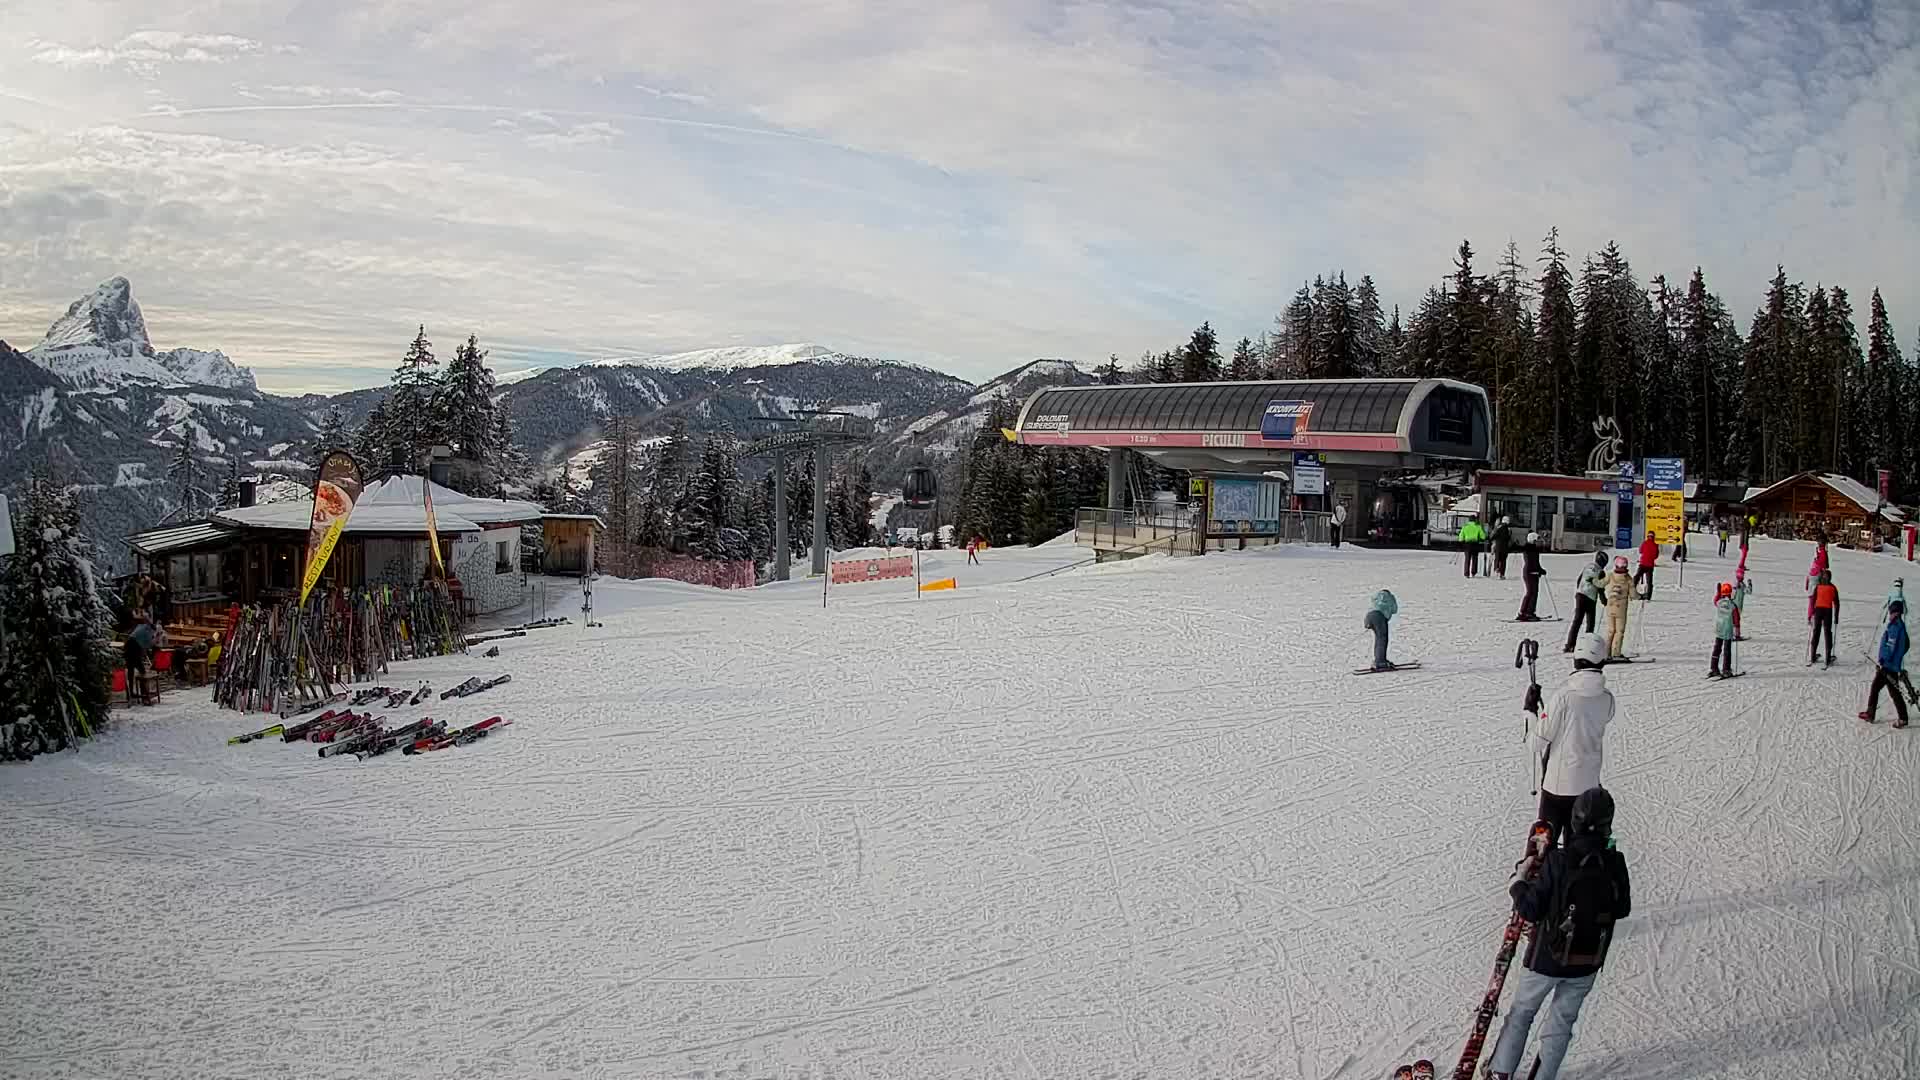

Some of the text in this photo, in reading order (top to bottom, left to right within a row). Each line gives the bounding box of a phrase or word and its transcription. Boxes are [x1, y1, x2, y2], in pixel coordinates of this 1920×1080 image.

[1036, 414, 1069, 422] DOLOMITI
[1202, 434, 1245, 447] PICULIN
[303, 526, 341, 590] RESTAURANT
